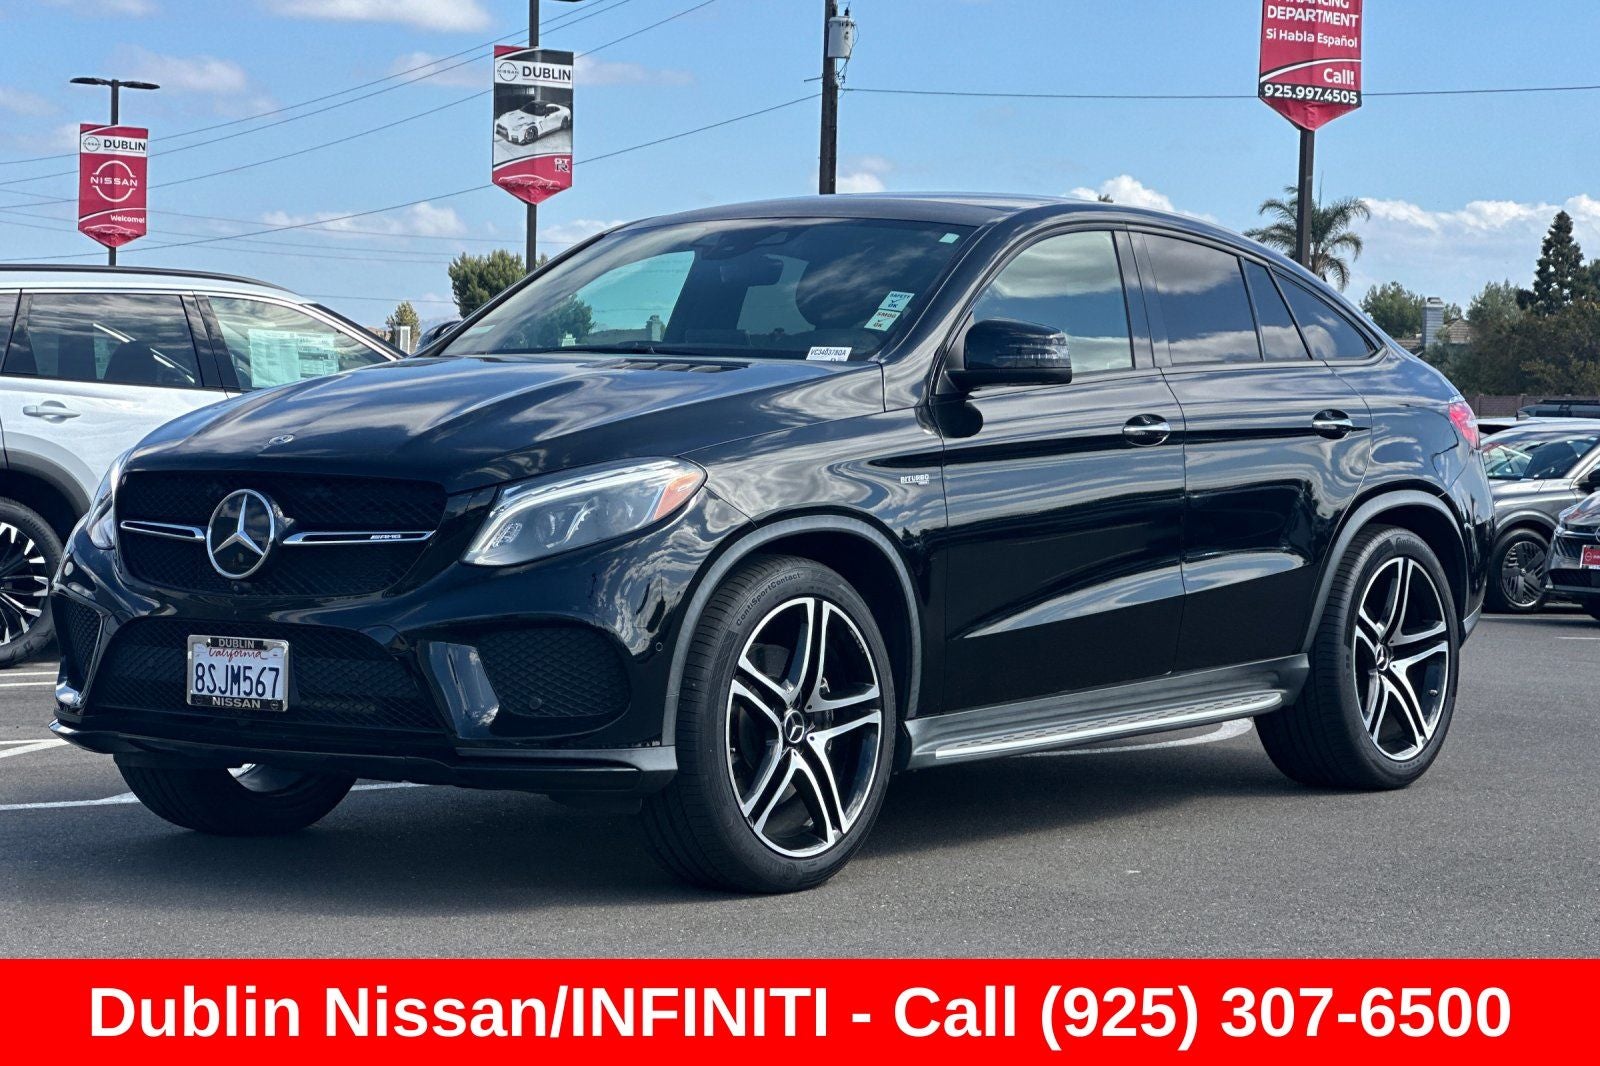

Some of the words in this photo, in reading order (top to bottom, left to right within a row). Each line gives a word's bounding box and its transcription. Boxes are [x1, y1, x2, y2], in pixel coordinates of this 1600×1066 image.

[1267, 5, 1359, 28] DEPARTMENT
[1266, 28, 1277, 40] Si
[1279, 30, 1315, 43] Habla
[1317, 33, 1358, 48] Español
[522, 66, 571, 81] DUBLIN
[1323, 68, 1355, 85] Call!
[1264, 84, 1358, 104] 925.997.4505
[103, 139, 146, 151] DUBLIN
[90, 176, 138, 187] NISSAN
[110, 214, 145, 224] Welcome!
[218, 639, 255, 649] DUBLIN
[208, 647, 268, 663] California
[195, 662, 280, 698] 8SJM567
[212, 697, 261, 708] NISSAN
